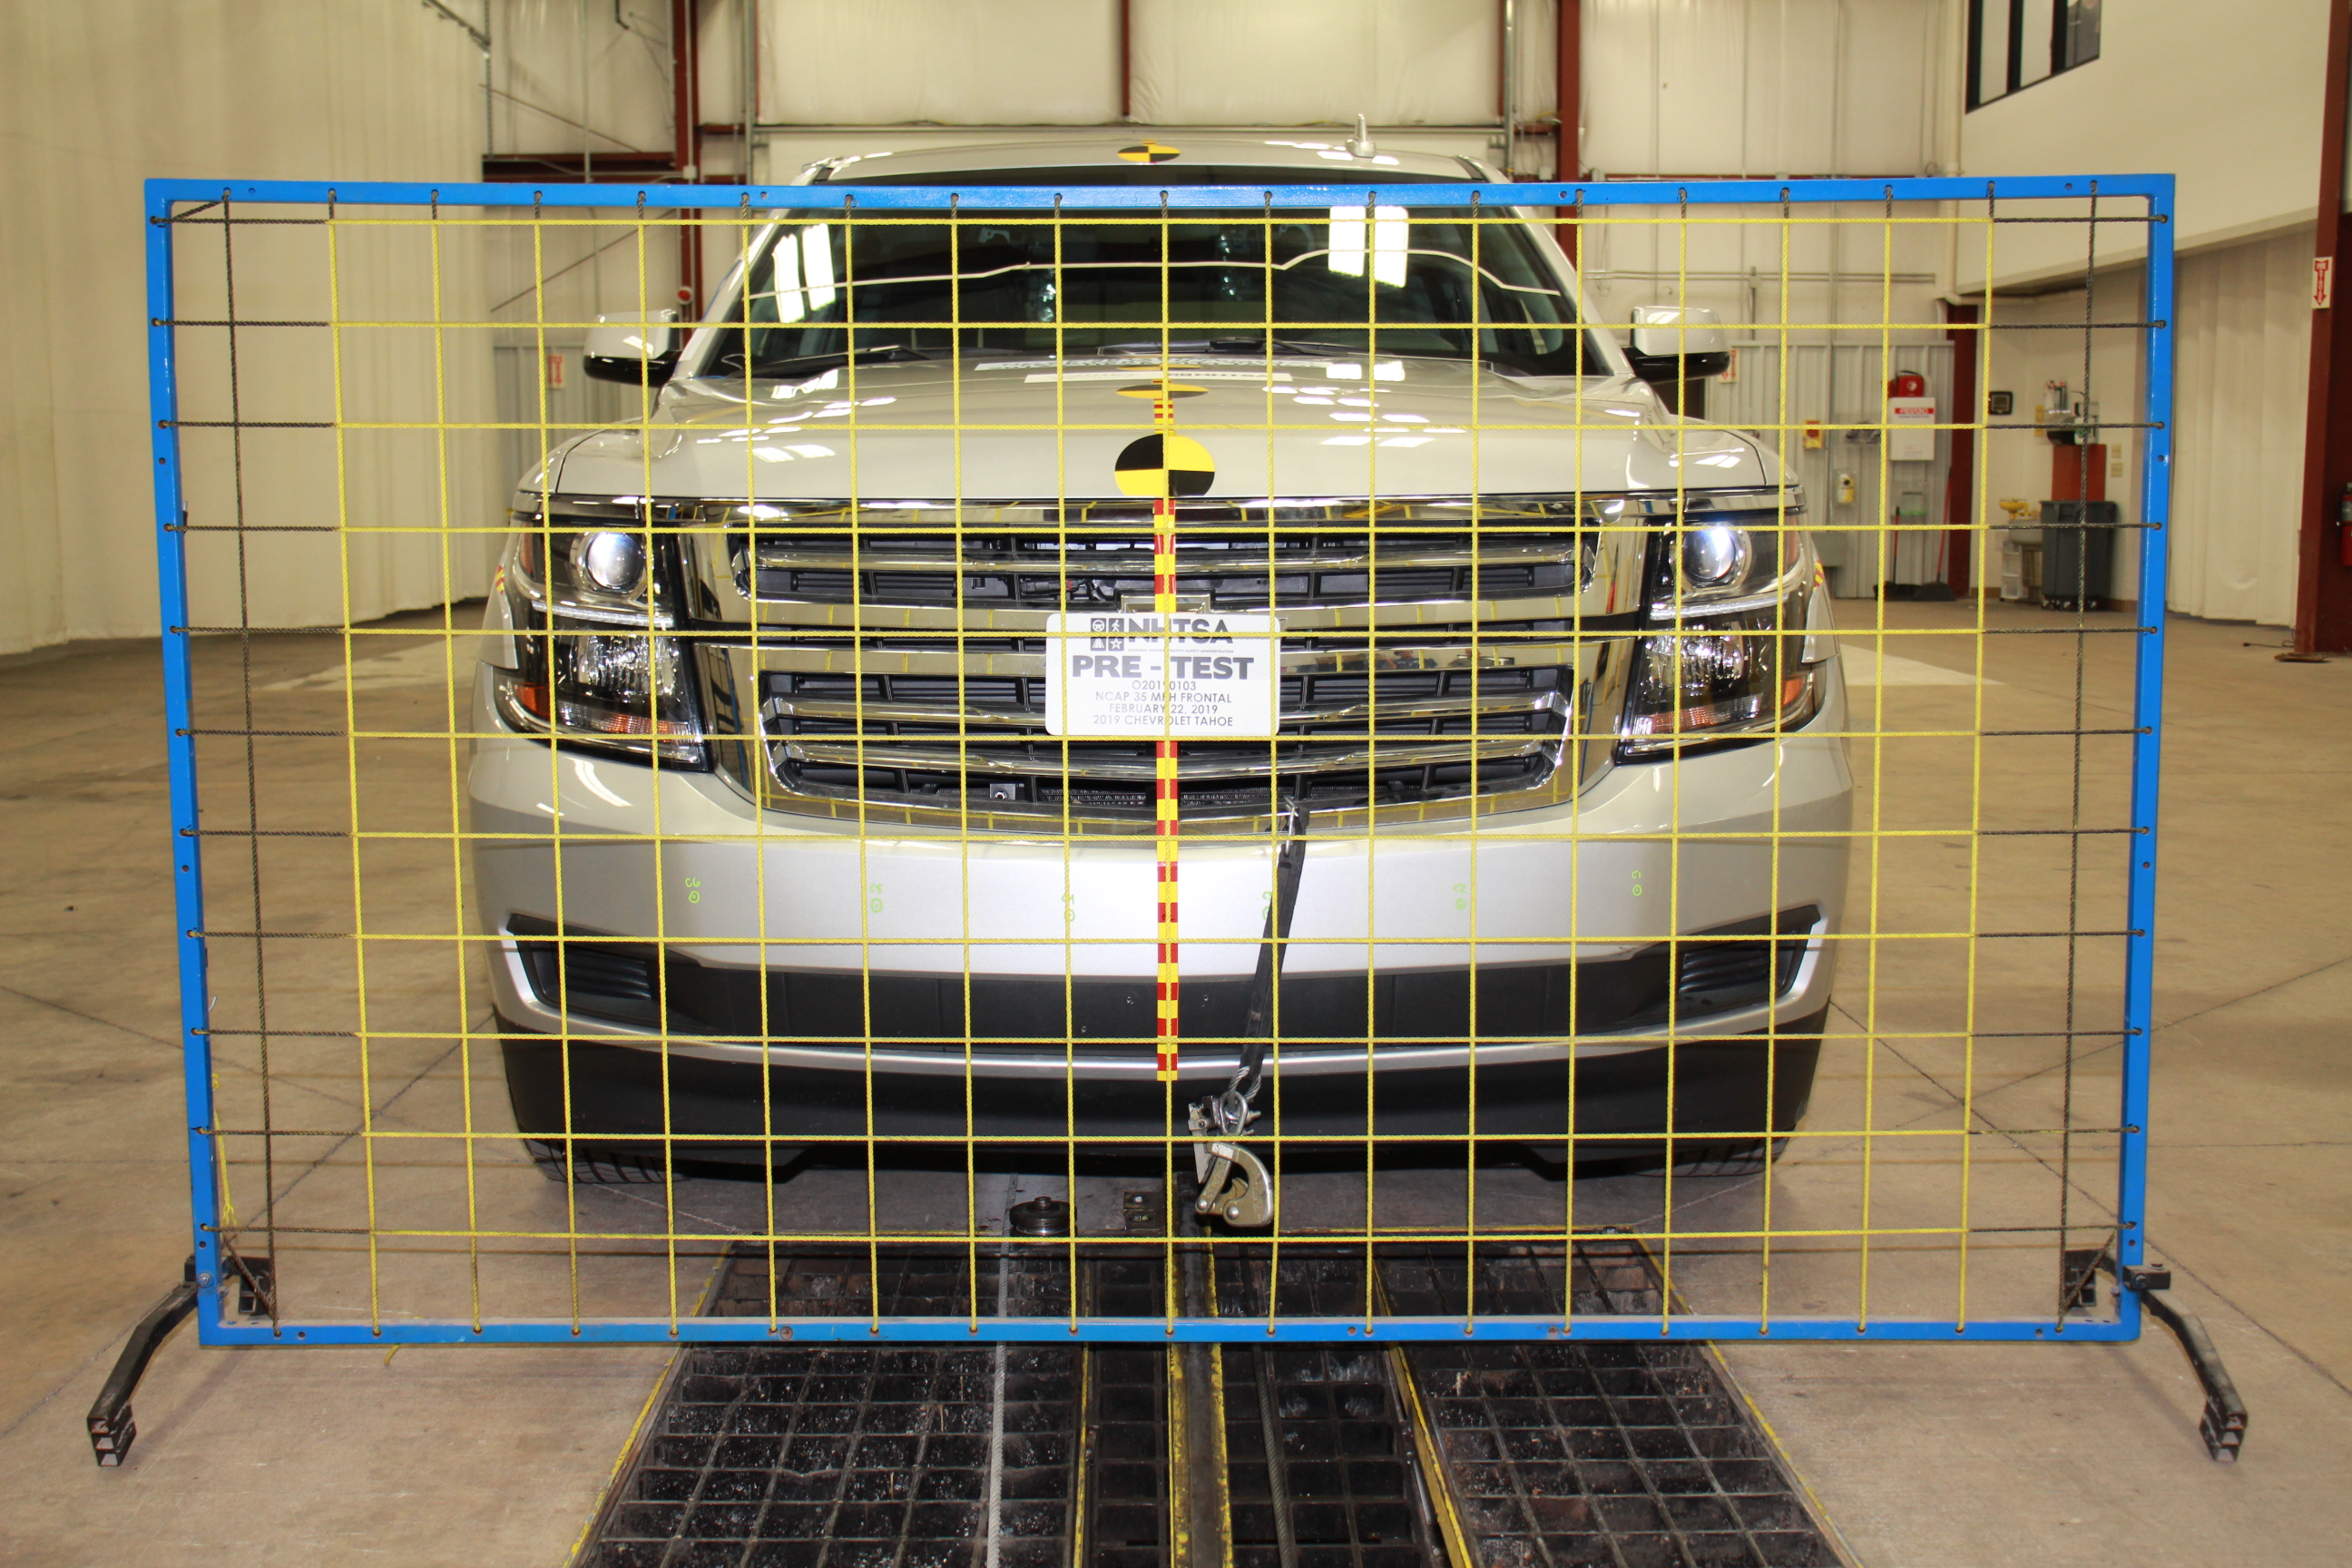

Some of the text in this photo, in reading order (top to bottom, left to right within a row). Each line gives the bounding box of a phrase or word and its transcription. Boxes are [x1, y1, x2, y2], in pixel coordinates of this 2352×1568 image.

[1128, 617, 1234, 644] NHTSA
[1072, 654, 1142, 678] PRE
[1170, 656, 1255, 680] TEST
[1132, 680, 1197, 691] O2010103
[1095, 691, 1130, 701] NCAP
[1133, 691, 1147, 702] 35
[1181, 692, 1232, 703] FRONTAL
[1109, 703, 1218, 716] FEBRUARY 22, 2019
[1093, 714, 1121, 725] 2019
[1194, 716, 1233, 727] TAHOE
